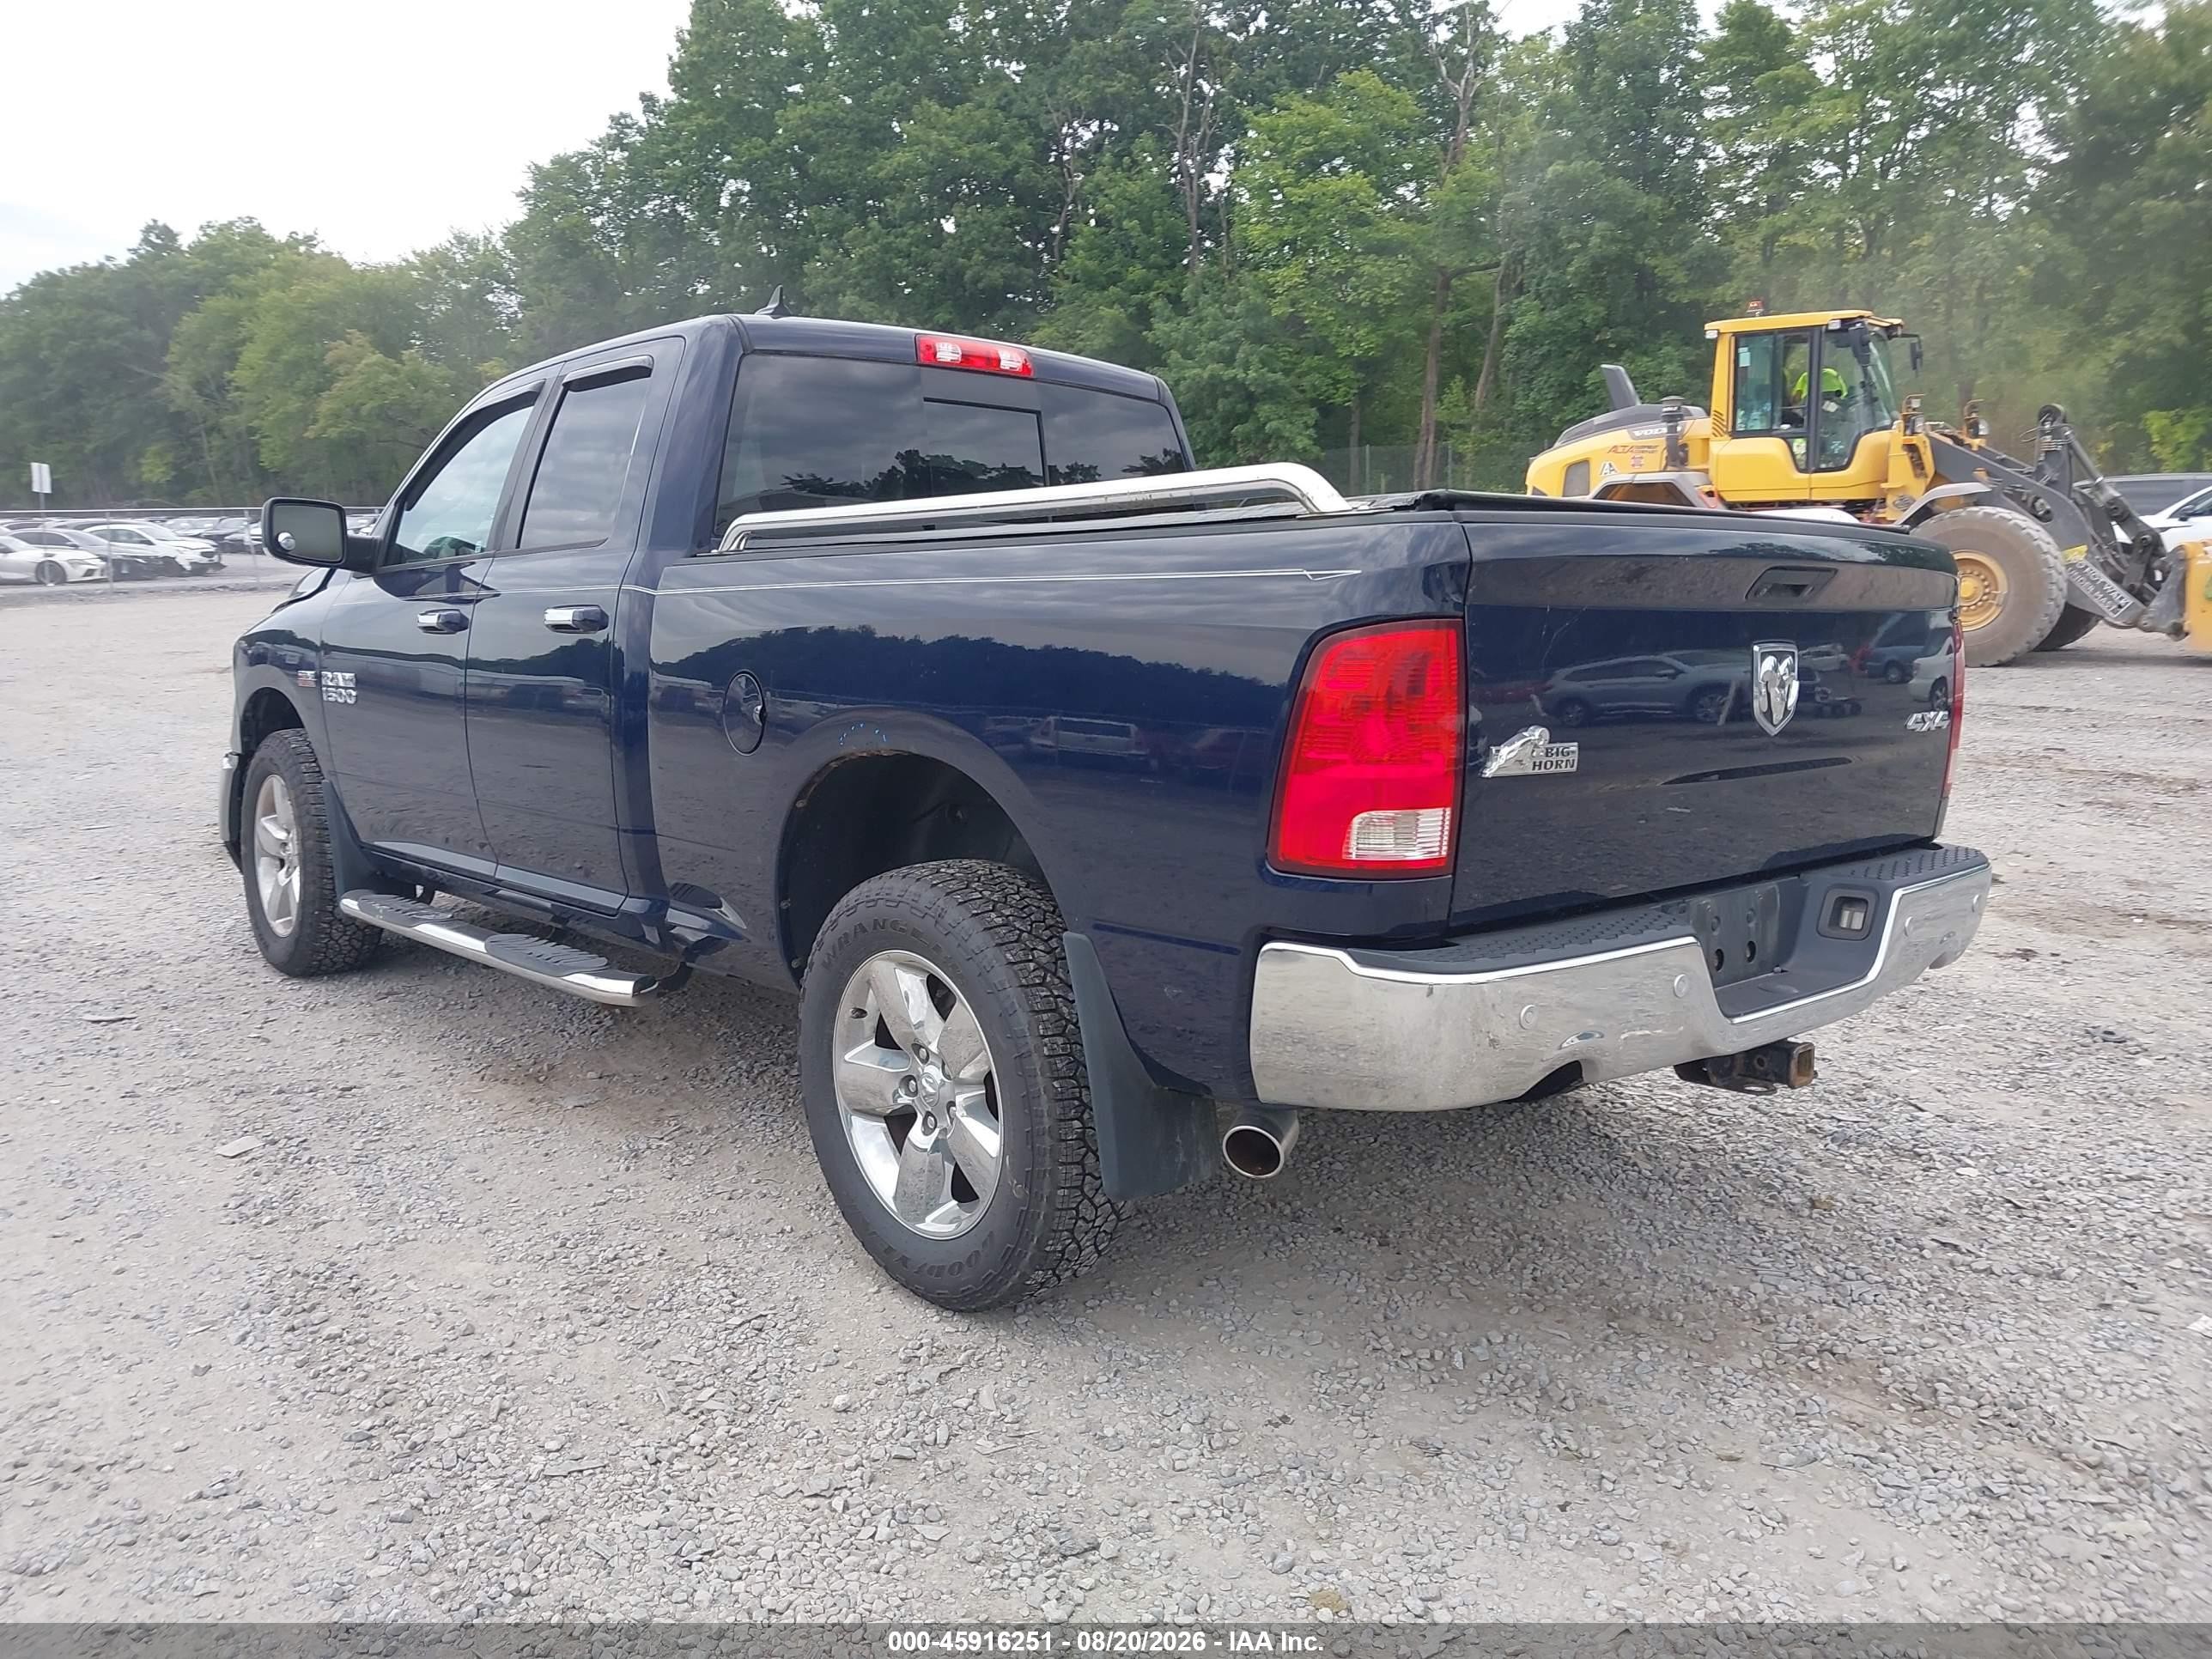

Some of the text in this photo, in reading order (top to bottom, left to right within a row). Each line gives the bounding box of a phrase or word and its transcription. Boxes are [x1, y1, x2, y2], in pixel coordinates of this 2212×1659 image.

[1632, 425, 1682, 436] VOLV
[320, 672, 356, 688] RAM
[322, 687, 357, 704] 1500
[1545, 746, 1571, 758] BIG
[1532, 758, 1576, 771] HORN
